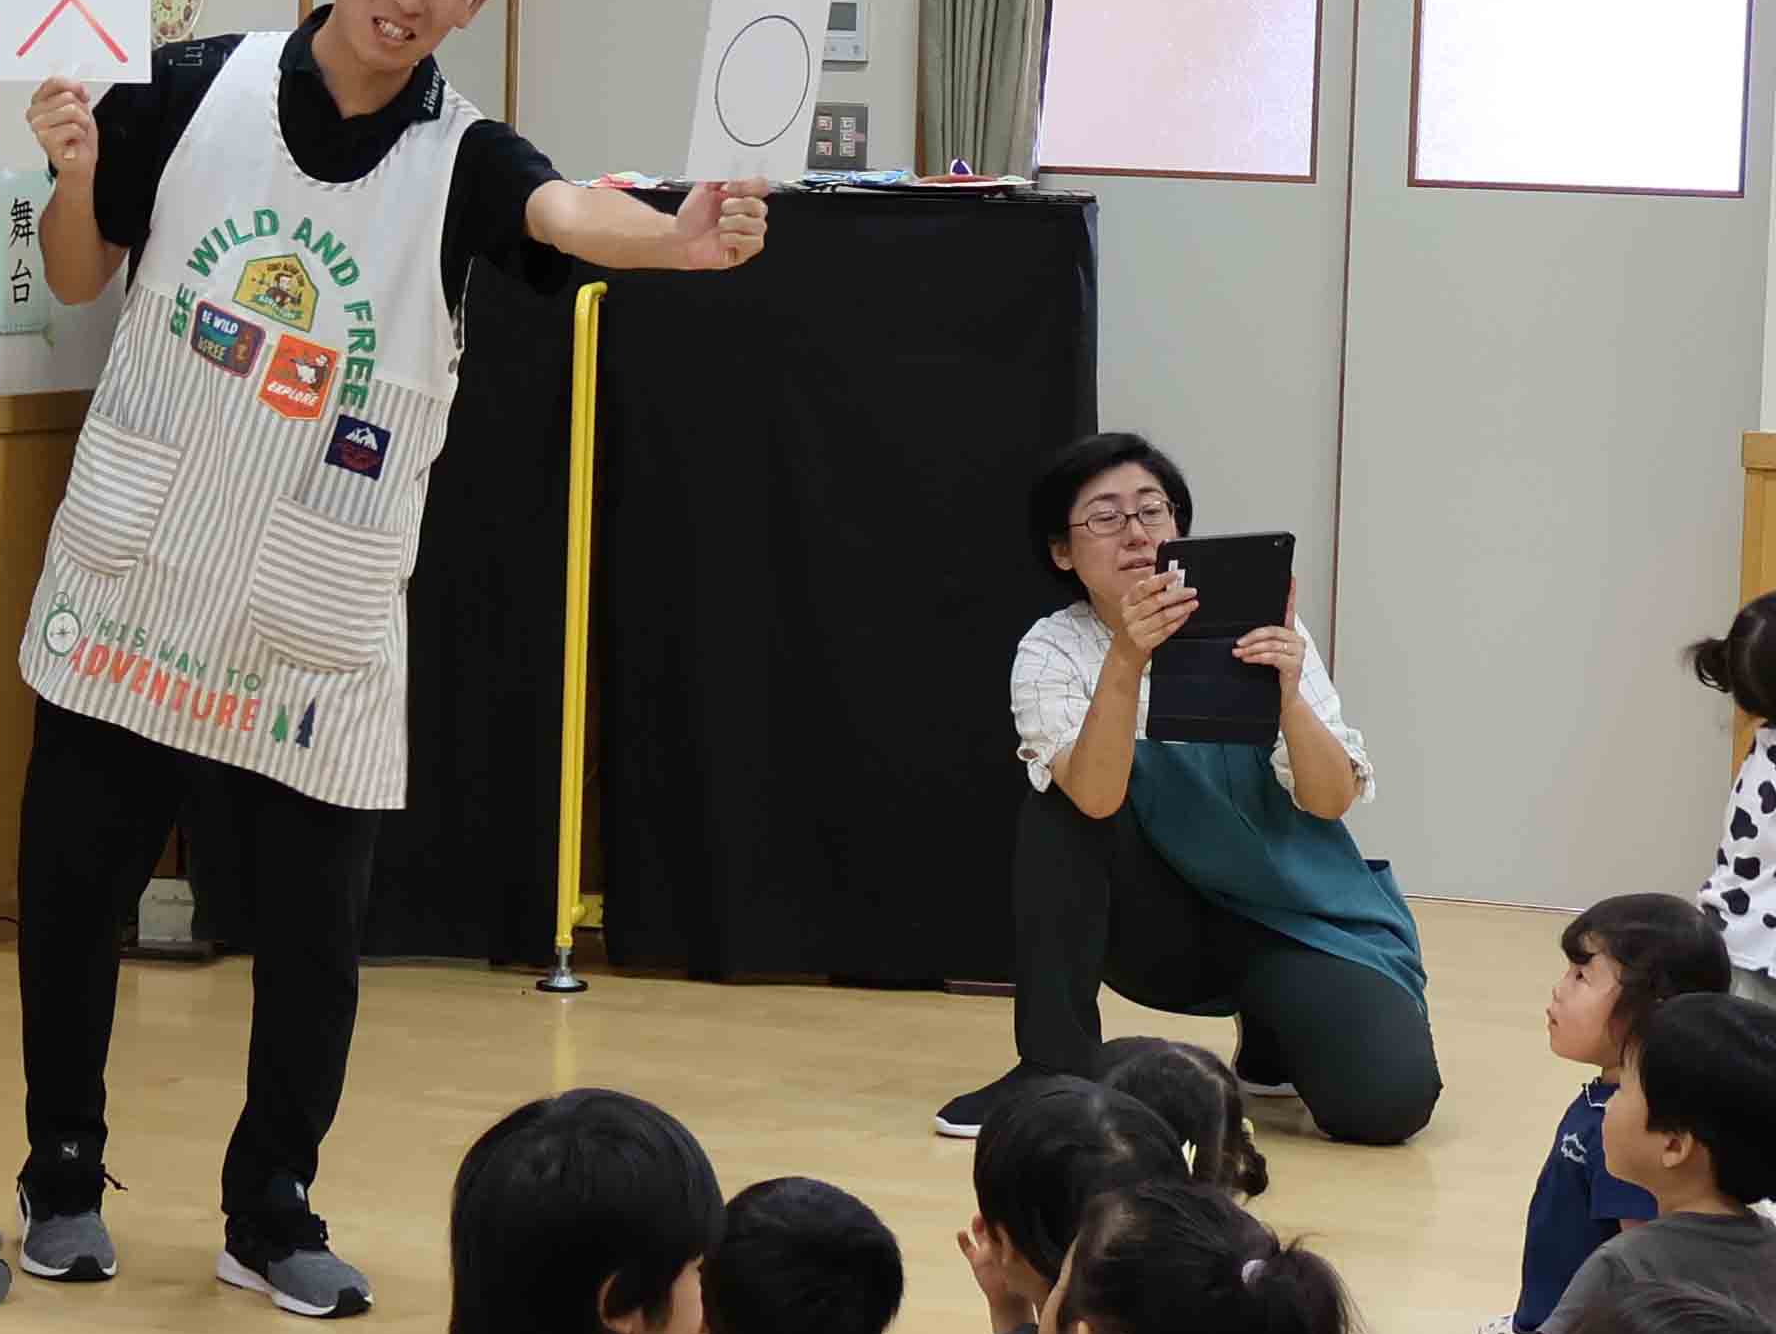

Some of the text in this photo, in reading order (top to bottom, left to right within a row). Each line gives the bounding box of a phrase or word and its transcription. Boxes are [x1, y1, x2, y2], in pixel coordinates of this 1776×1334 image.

[9, 197, 36, 304] 舞台
[170, 208, 376, 411] BE WILD AND FREE
[214, 314, 239, 334] WILD
[266, 381, 320, 406] EXPLORE
[68, 634, 262, 732] ADVENTURE
[95, 613, 262, 691] HIS WAY TO
